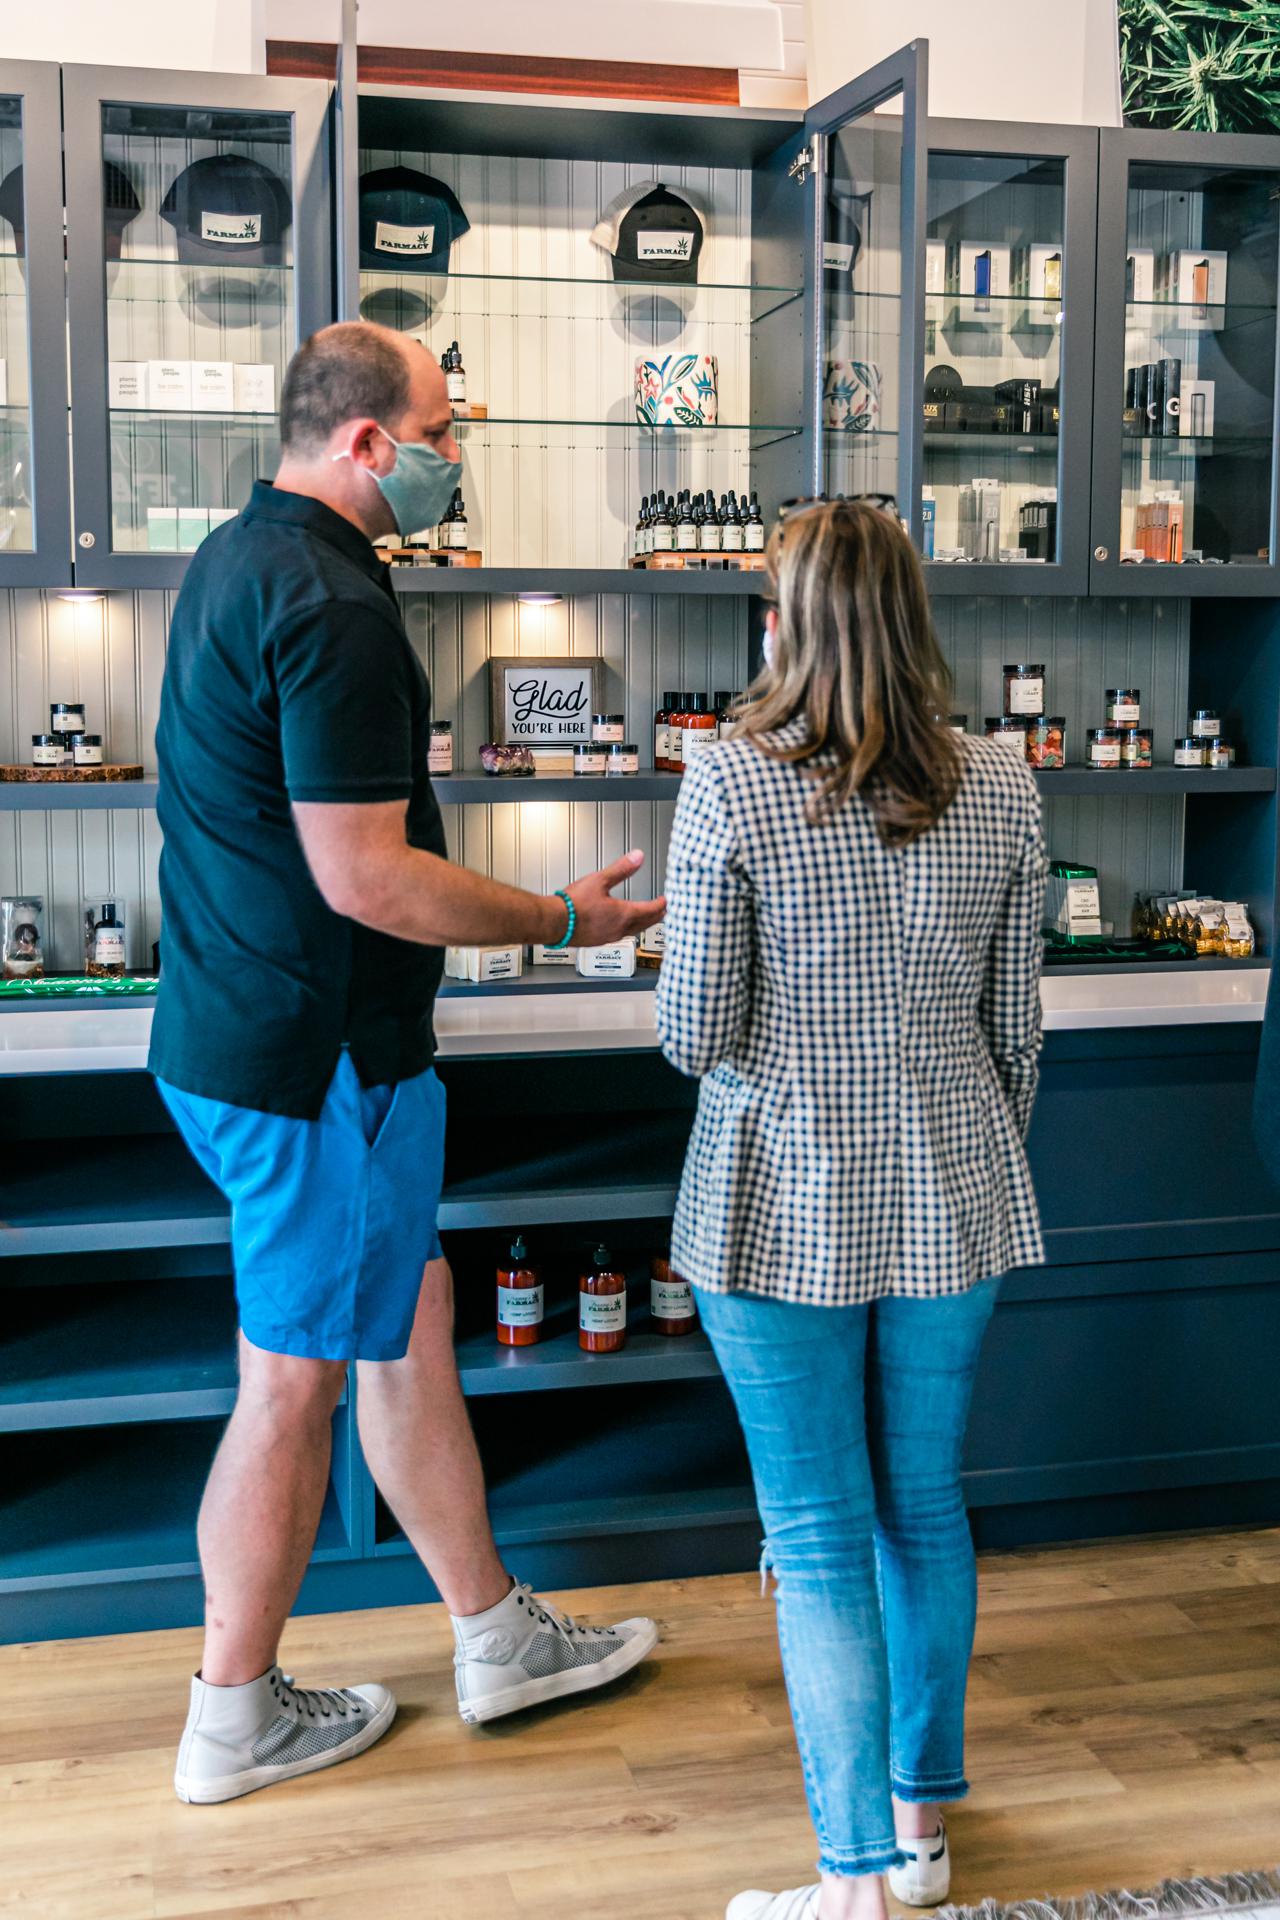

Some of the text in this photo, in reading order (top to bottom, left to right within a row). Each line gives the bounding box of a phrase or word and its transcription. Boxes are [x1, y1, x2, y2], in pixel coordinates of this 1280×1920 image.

[206, 229, 257, 239] FARMACY
[380, 240, 429, 250] FARMACY
[642, 248, 688, 256] FARMACY
[508, 679, 588, 721] Glad
[511, 722, 586, 733] YOU'RE HERE
